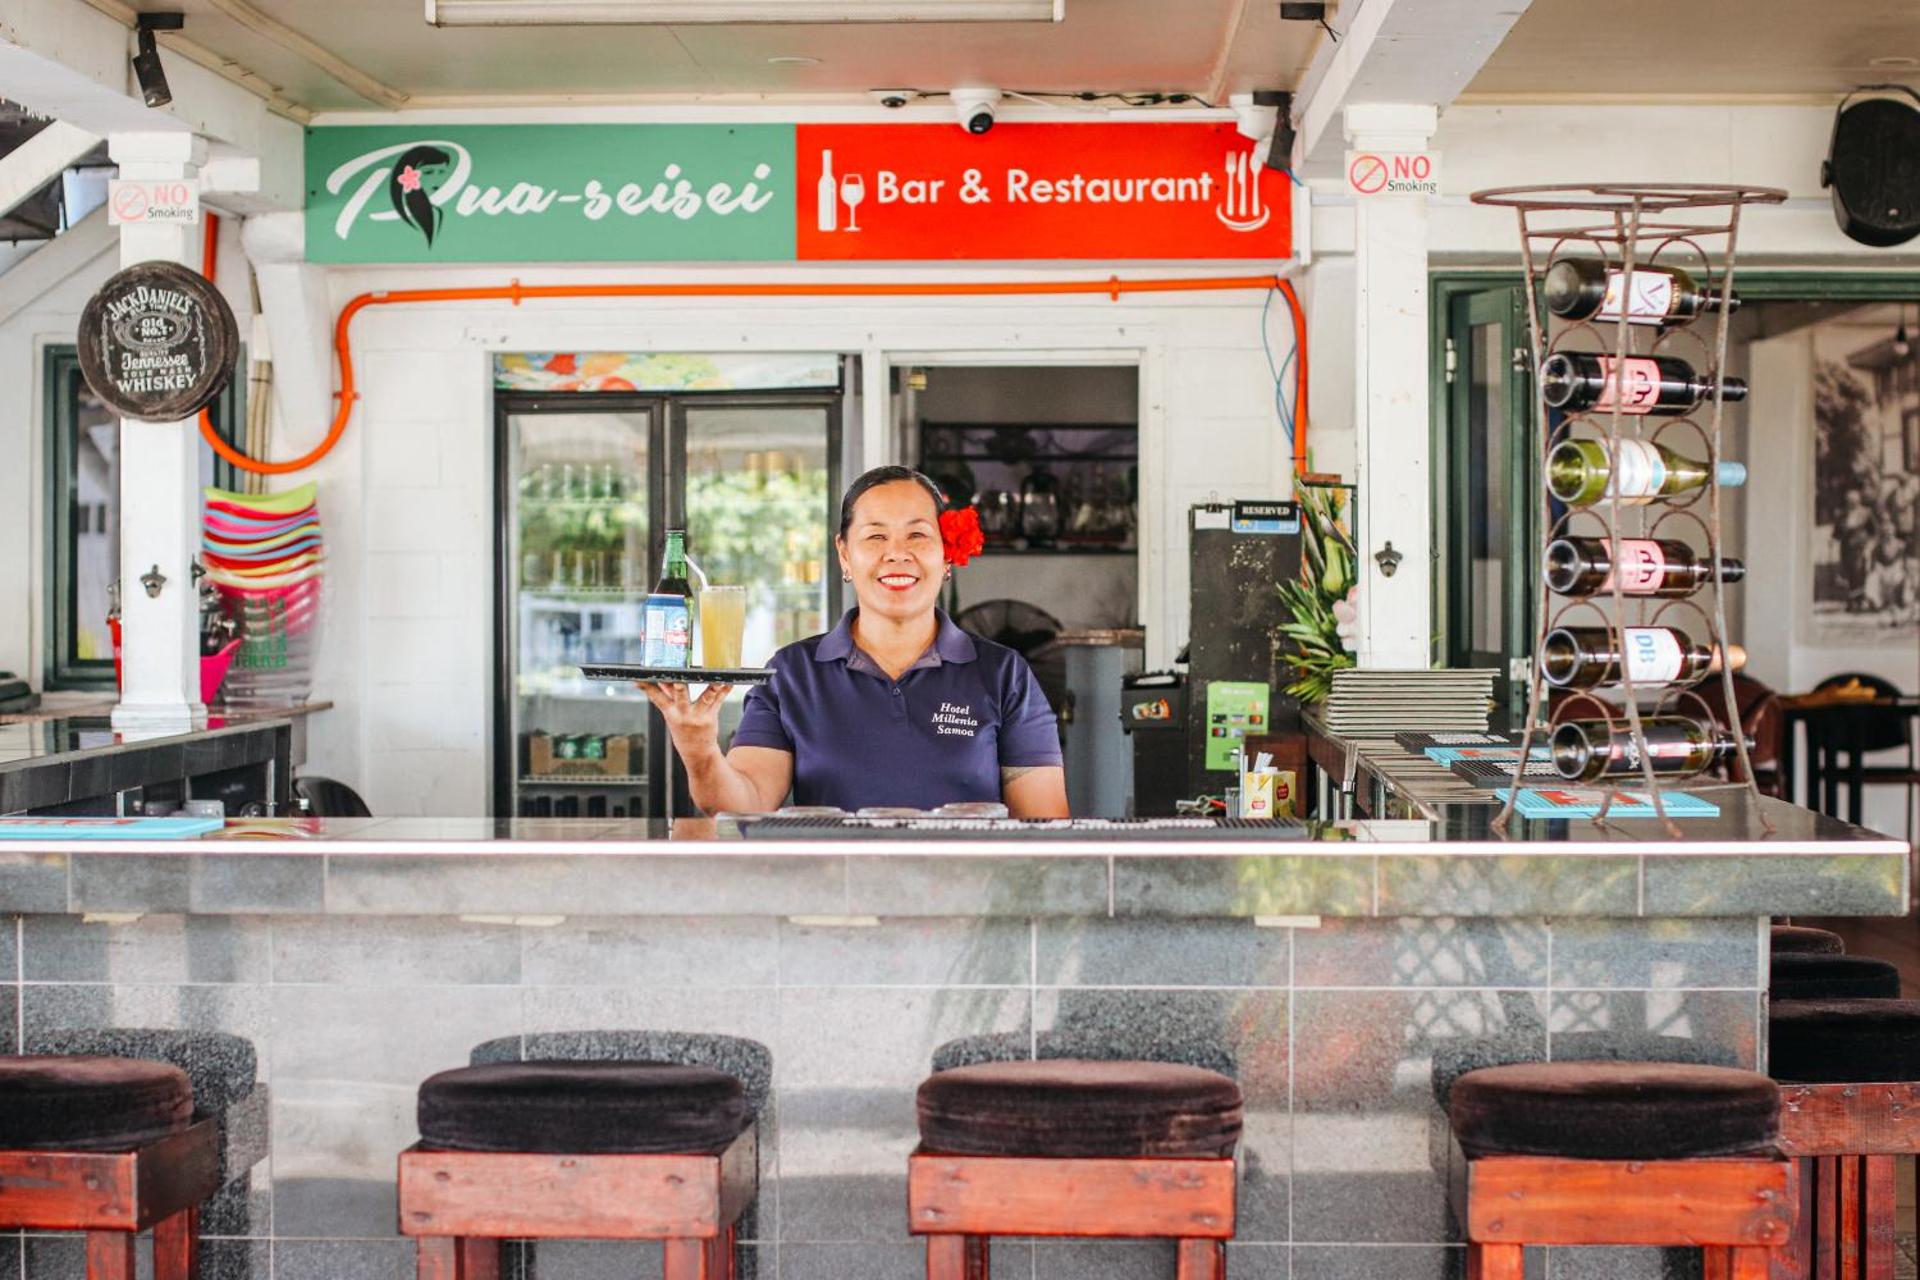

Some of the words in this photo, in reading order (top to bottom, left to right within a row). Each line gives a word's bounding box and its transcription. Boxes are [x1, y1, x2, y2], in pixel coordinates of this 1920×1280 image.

[1394, 155, 1431, 179] NO
[154, 184, 189, 206] NO
[326, 140, 774, 240] Pua-seisei
[877, 169, 945, 203] Bar
[959, 168, 991, 203] &
[1008, 168, 1213, 202] Restaurant
[1387, 179, 1437, 194] Smoking
[147, 206, 194, 221] Smoking
[106, 291, 140, 321] JACK
[136, 286, 193, 315] DANIEL'S
[121, 352, 189, 371] Tennessee
[116, 374, 197, 393] WHISKEY
[1241, 505, 1291, 516] RESERVED
[940, 702, 970, 715] Hotel
[931, 712, 978, 727] Millenia
[936, 724, 974, 737] Samoa
